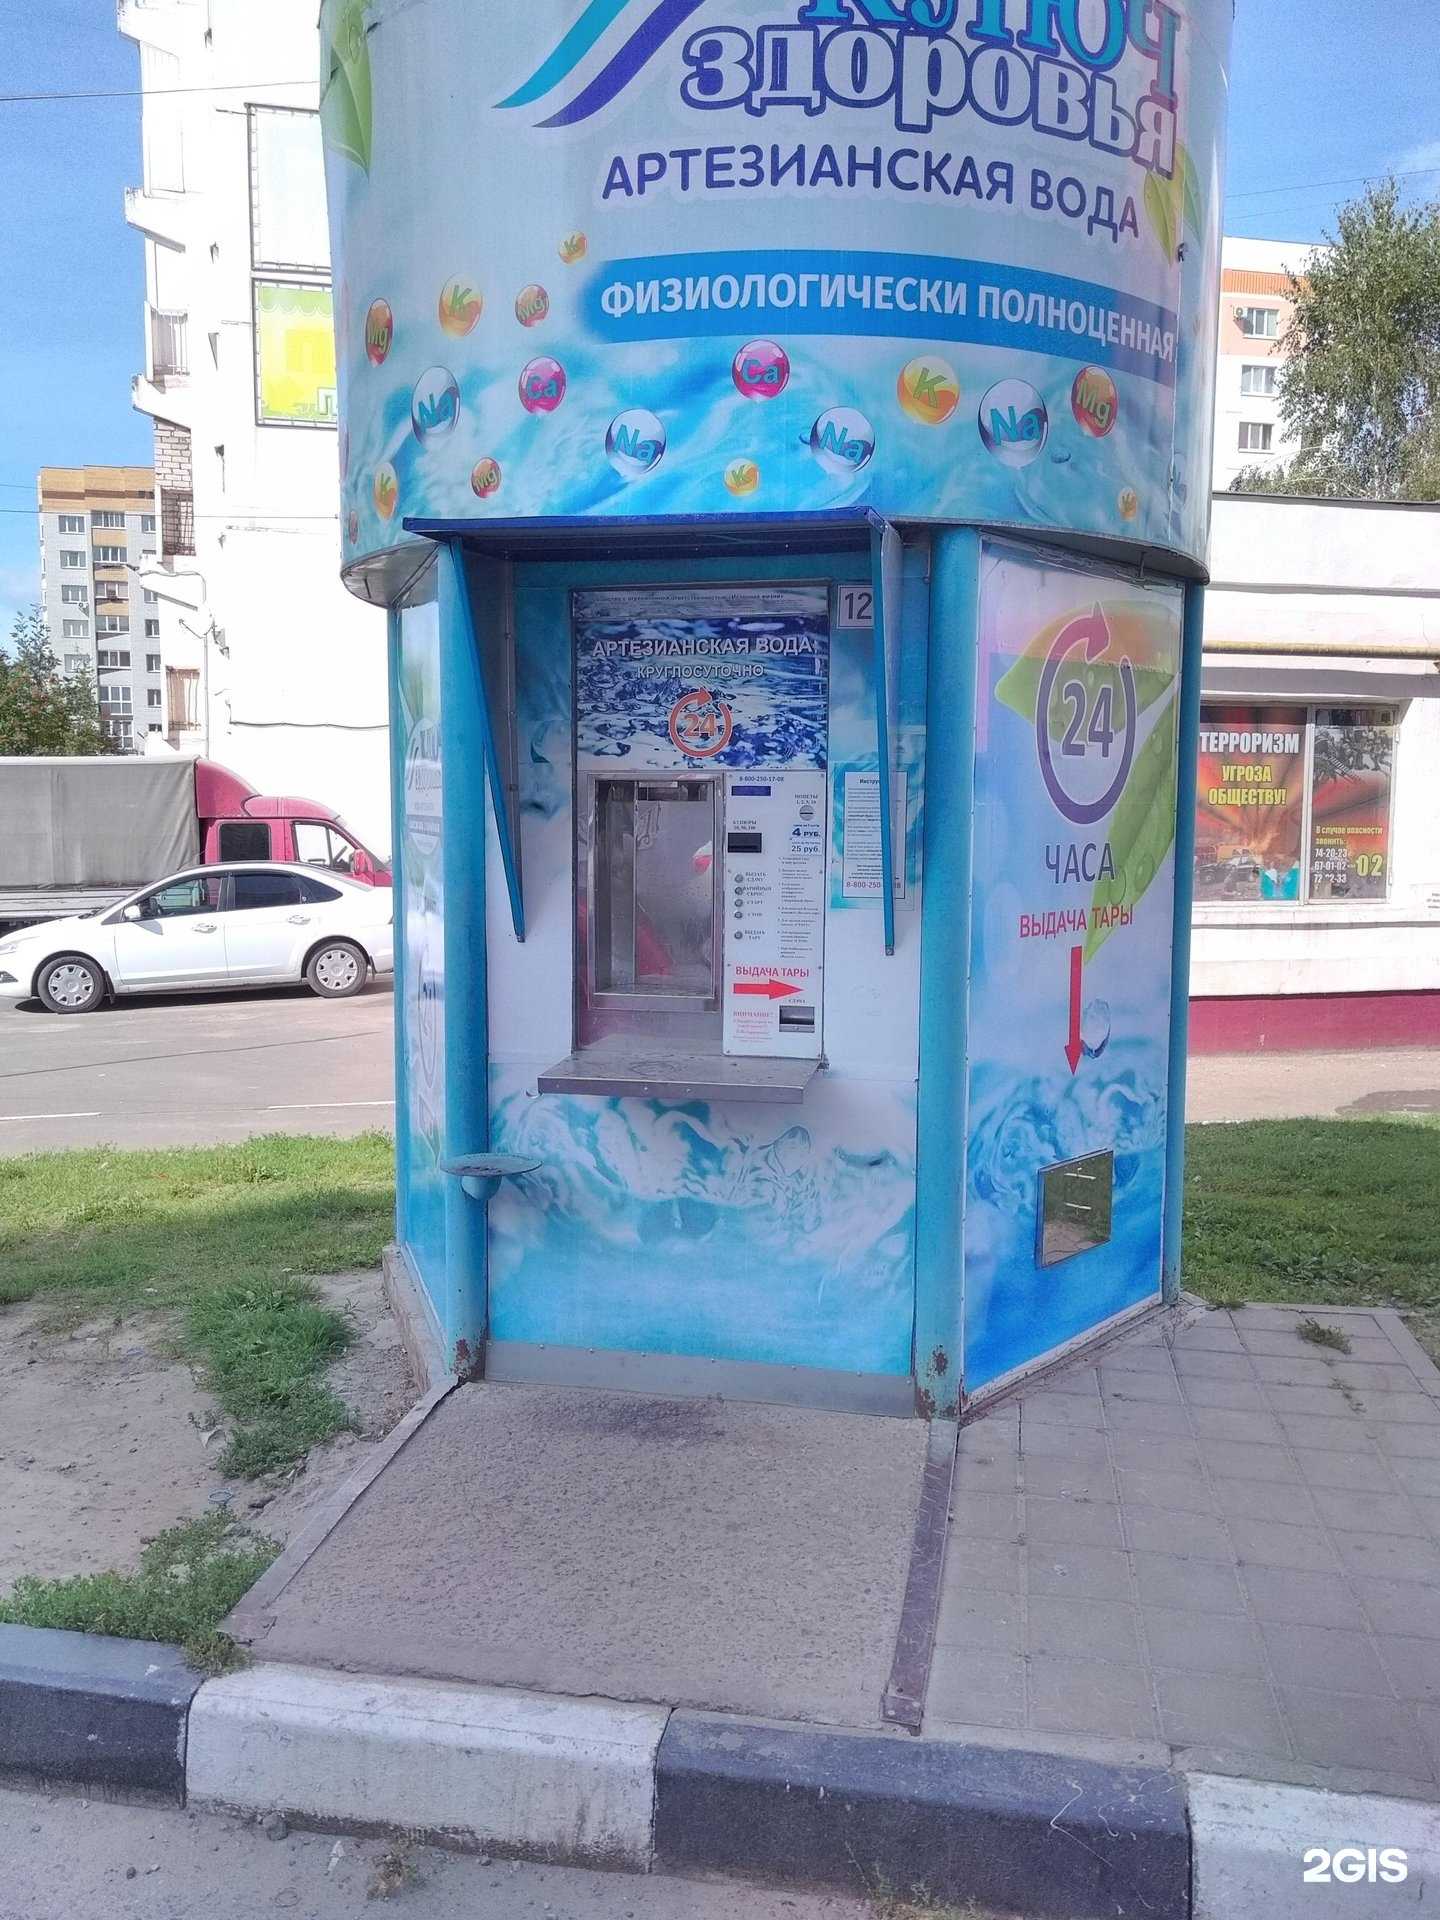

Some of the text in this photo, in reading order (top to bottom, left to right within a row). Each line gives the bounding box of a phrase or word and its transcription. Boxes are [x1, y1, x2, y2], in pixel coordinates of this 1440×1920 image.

[602, 145, 1141, 243] АРТЕЗИАНСКАЯ ВОДА
[601, 272, 1176, 364] ФИЗИОЛОГИЧЕСКИ ПОЛНОЦЕННАЯ
[742, 358, 780, 385] Ca
[525, 374, 558, 400] Ca
[913, 367, 947, 409] K
[417, 391, 454, 428] Na
[1076, 381, 1112, 428] Mg
[989, 406, 1041, 446] Na
[614, 424, 660, 462] Na
[820, 421, 864, 463] Na
[844, 593, 872, 620] 12
[592, 637, 812, 657] АРТЕЗИАНСКАЯ ВОДА
[636, 663, 764, 679] КРУГЛОСУТОЧНО
[683, 713, 716, 737] 24
[1062, 680, 1114, 758] 24
[1200, 732, 1299, 753] ТЕРРОРИЗМ
[1222, 765, 1272, 782] УГРОЗА
[1208, 788, 1288, 806] ОБЩЕСТВУ!
[792, 828, 802, 837] 4
[1045, 843, 1116, 884] ЧАСА
[1356, 854, 1383, 876] 02
[1019, 903, 1134, 940] ВЫДАЧА ТАРЫ
[736, 966, 810, 978] ВЫДАЧА ТАРЫ
